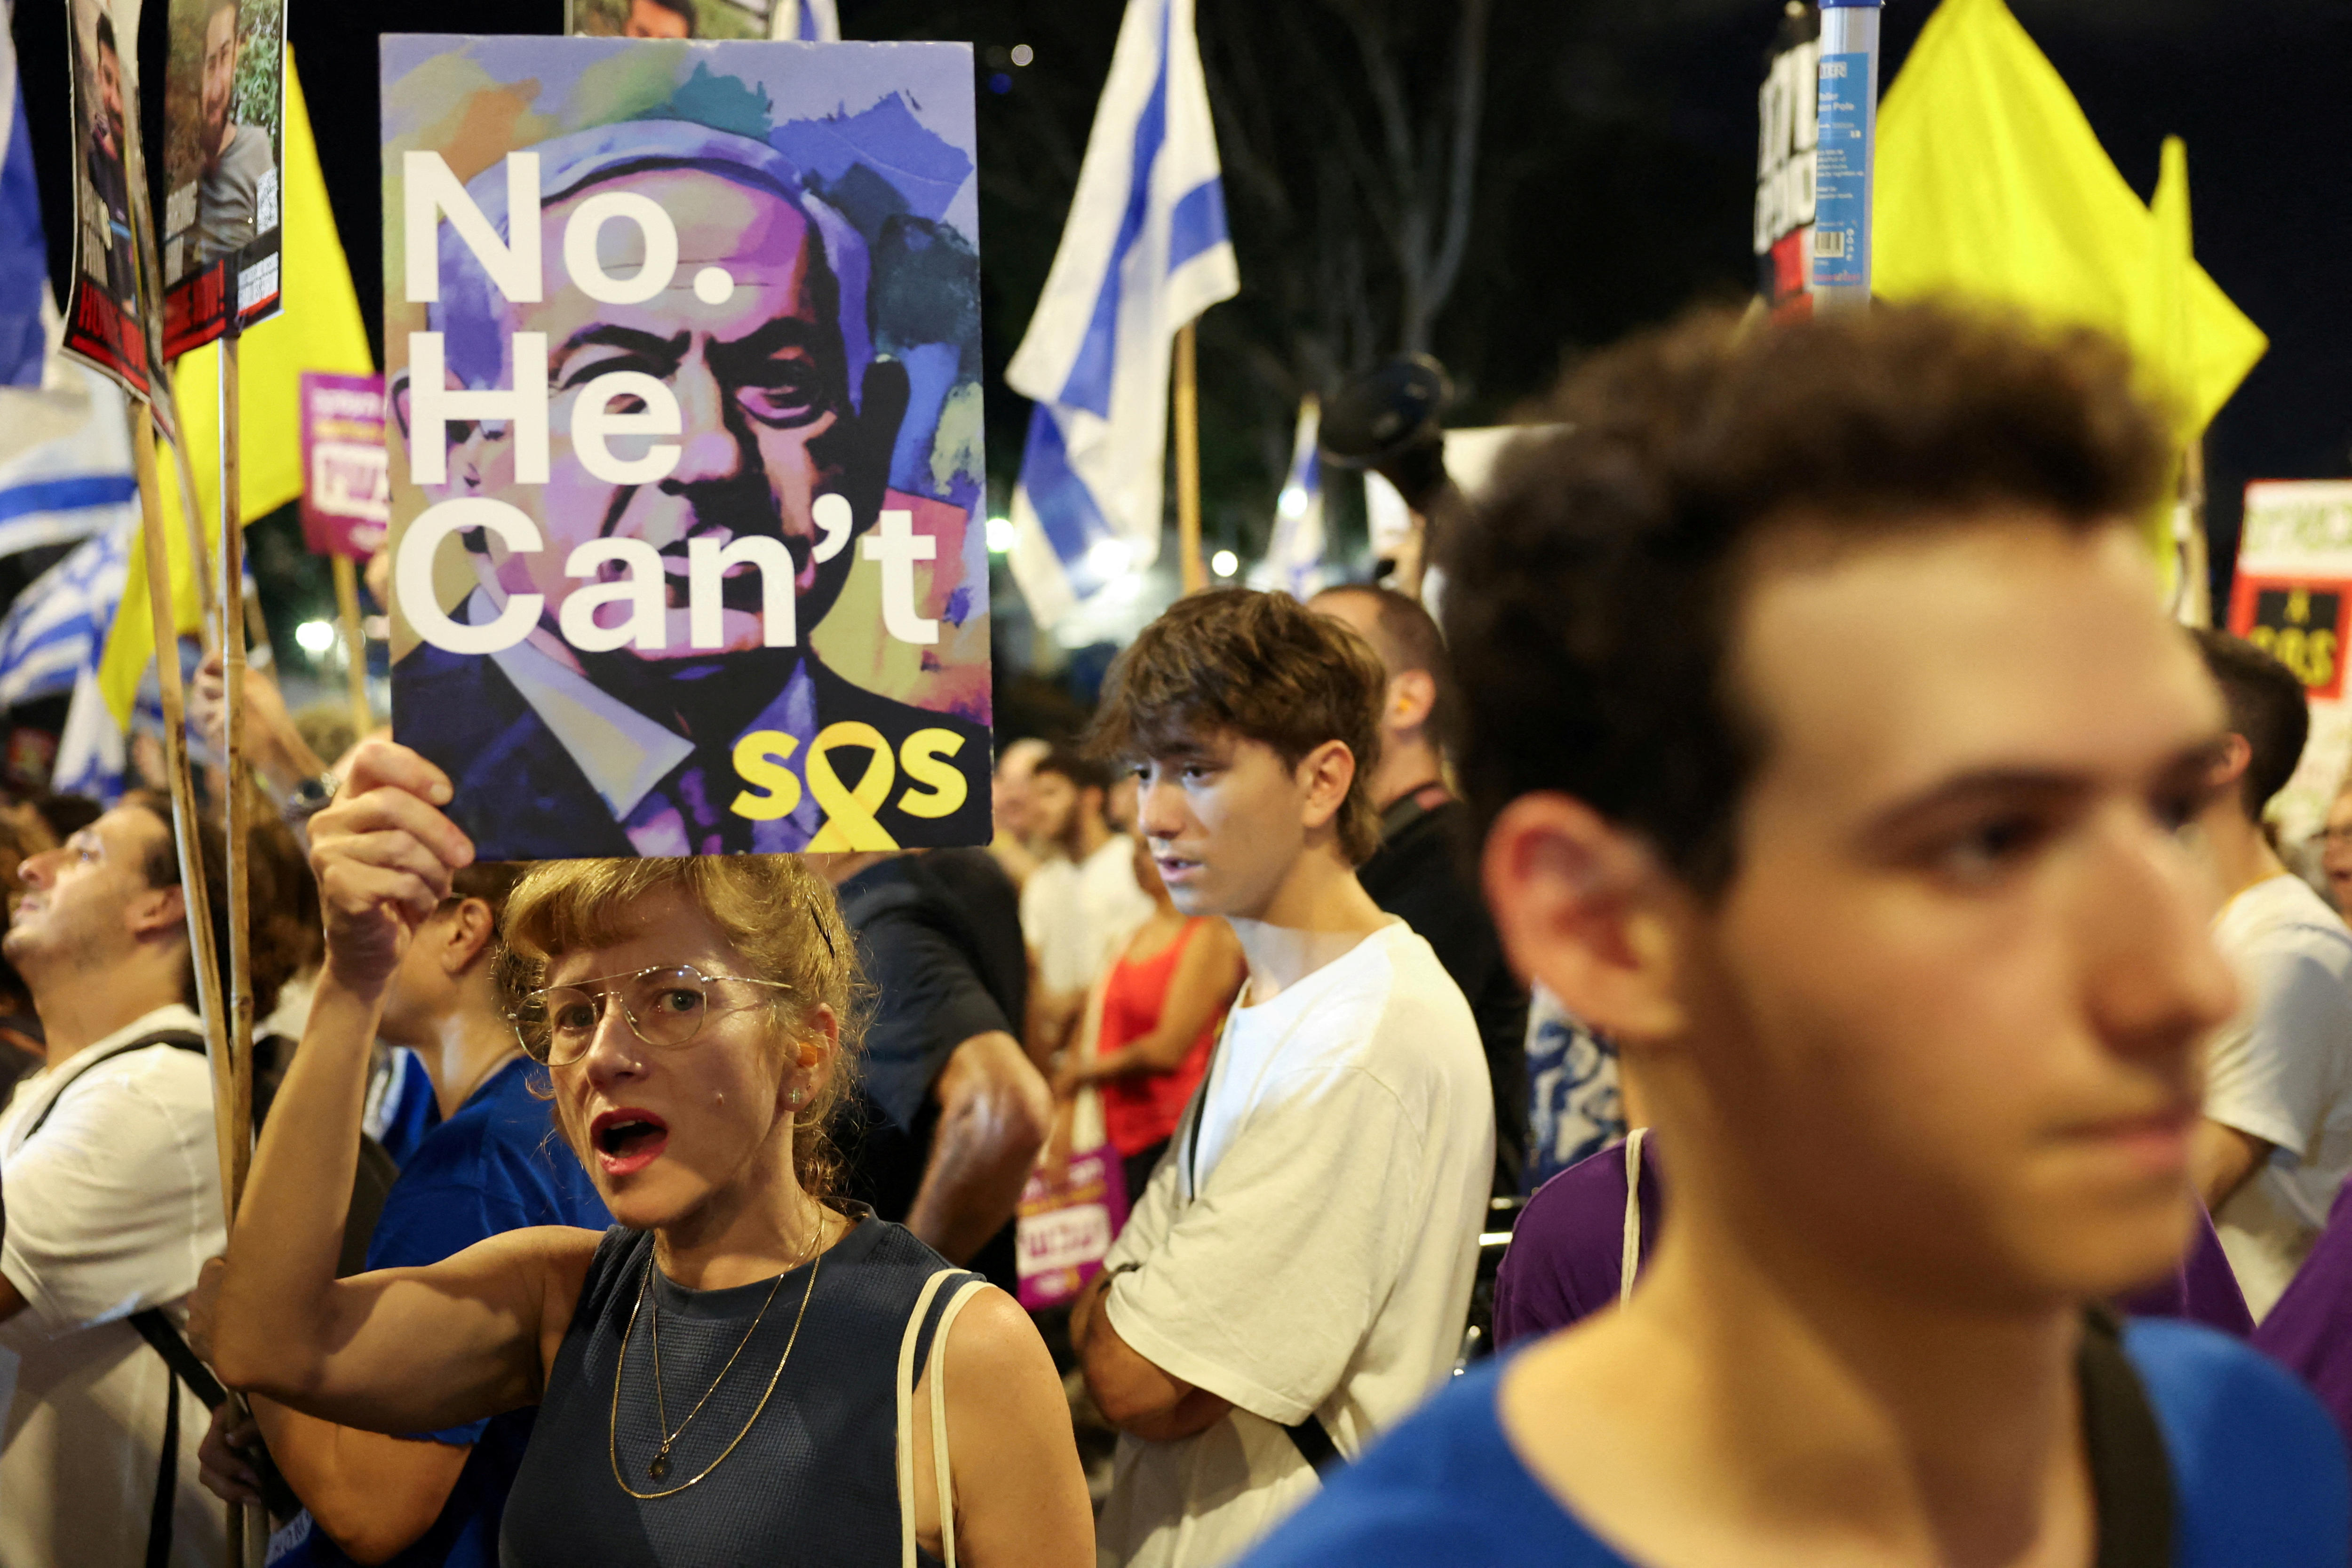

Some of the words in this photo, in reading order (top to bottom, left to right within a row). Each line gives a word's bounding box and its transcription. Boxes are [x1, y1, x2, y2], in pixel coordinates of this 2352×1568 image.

[403, 150, 734, 305] No.
[409, 331, 683, 486] He
[395, 493, 939, 655] Can't
